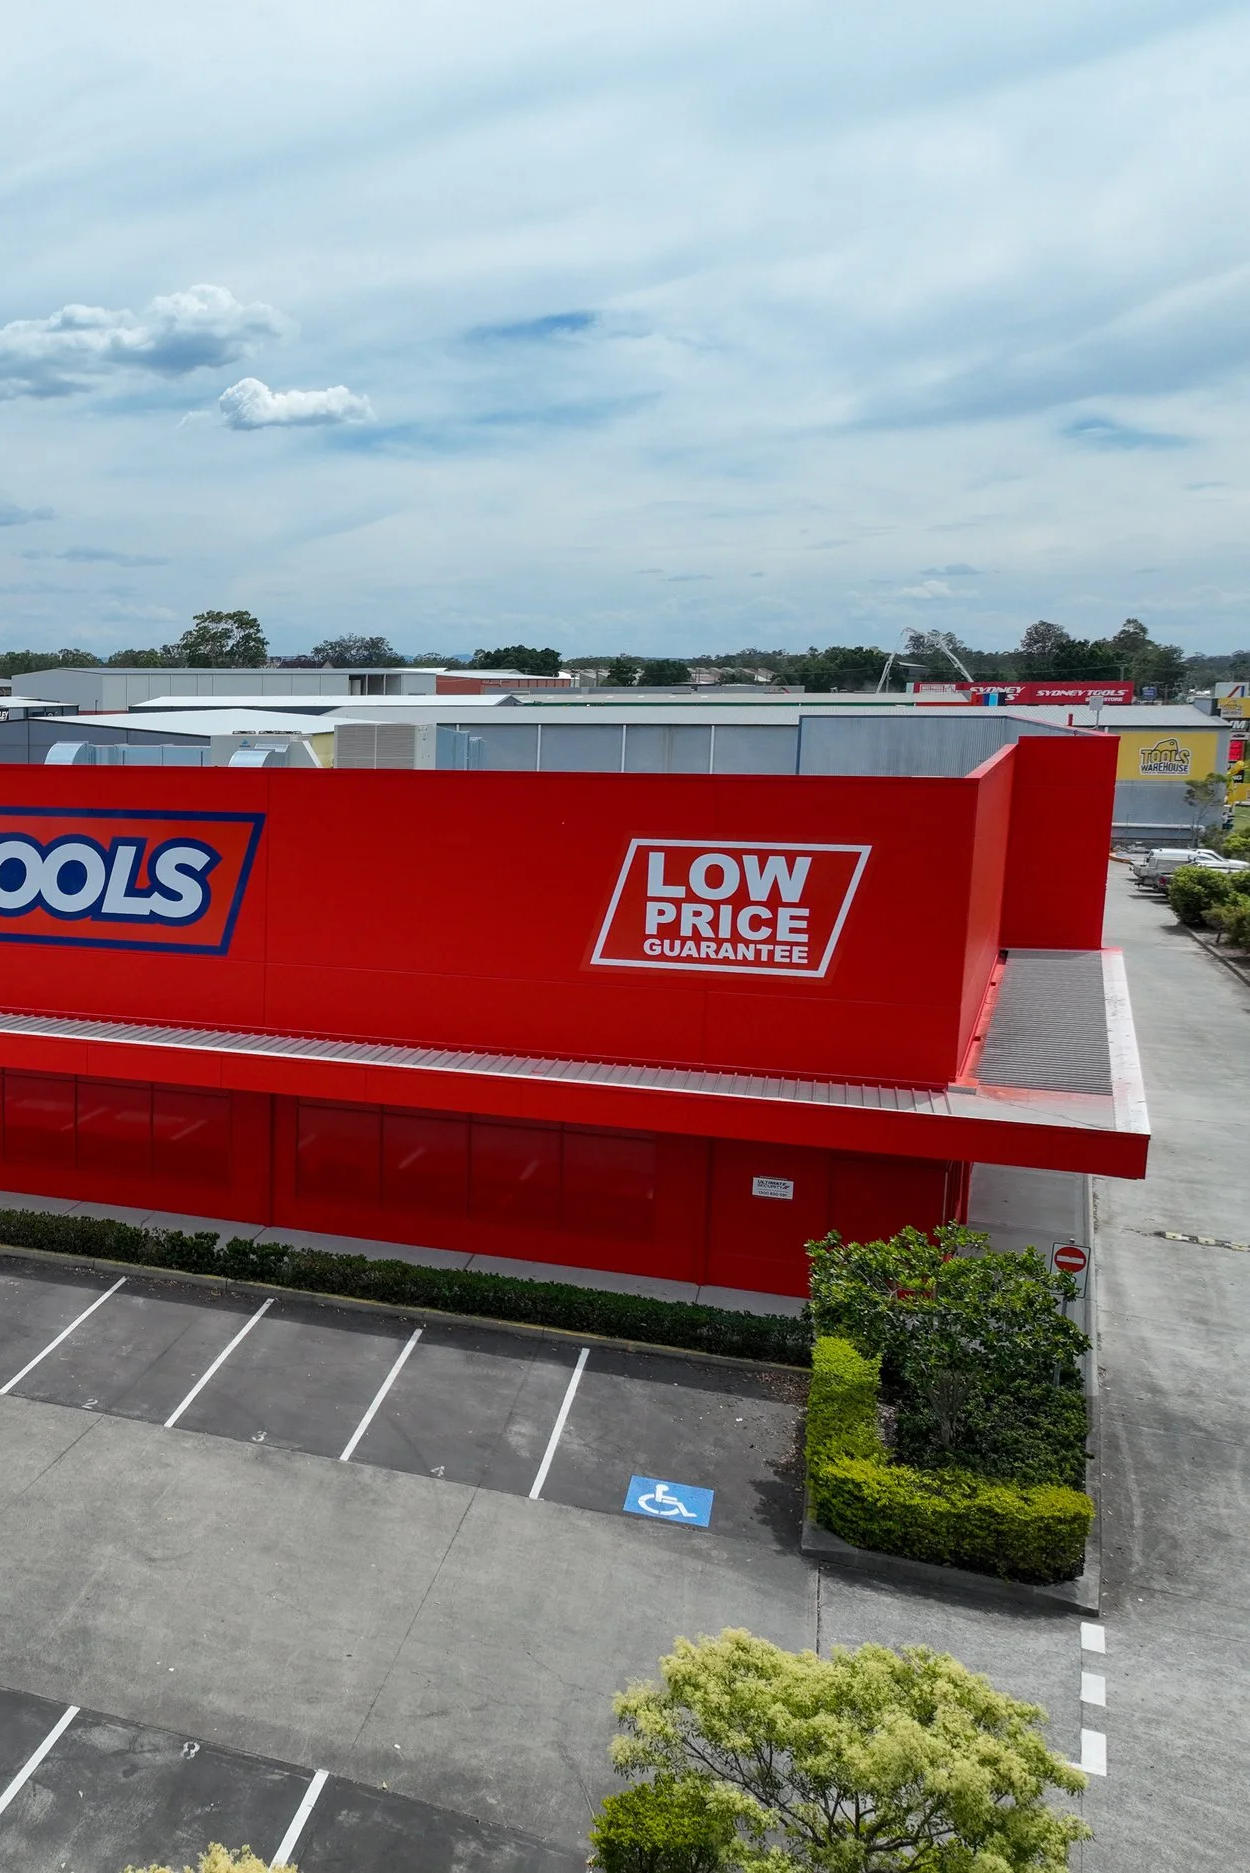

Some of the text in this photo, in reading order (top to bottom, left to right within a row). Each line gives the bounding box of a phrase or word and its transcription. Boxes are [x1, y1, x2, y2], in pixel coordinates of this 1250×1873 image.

[1140, 749, 1191, 764] TOOLS
[1141, 762, 1188, 772] WAREHOUSE
[647, 851, 812, 903] LOW
[645, 901, 809, 942] PRICE
[643, 938, 808, 964] GUARANTEE
[82, 1398, 98, 1410] 2
[251, 1431, 267, 1443] 3
